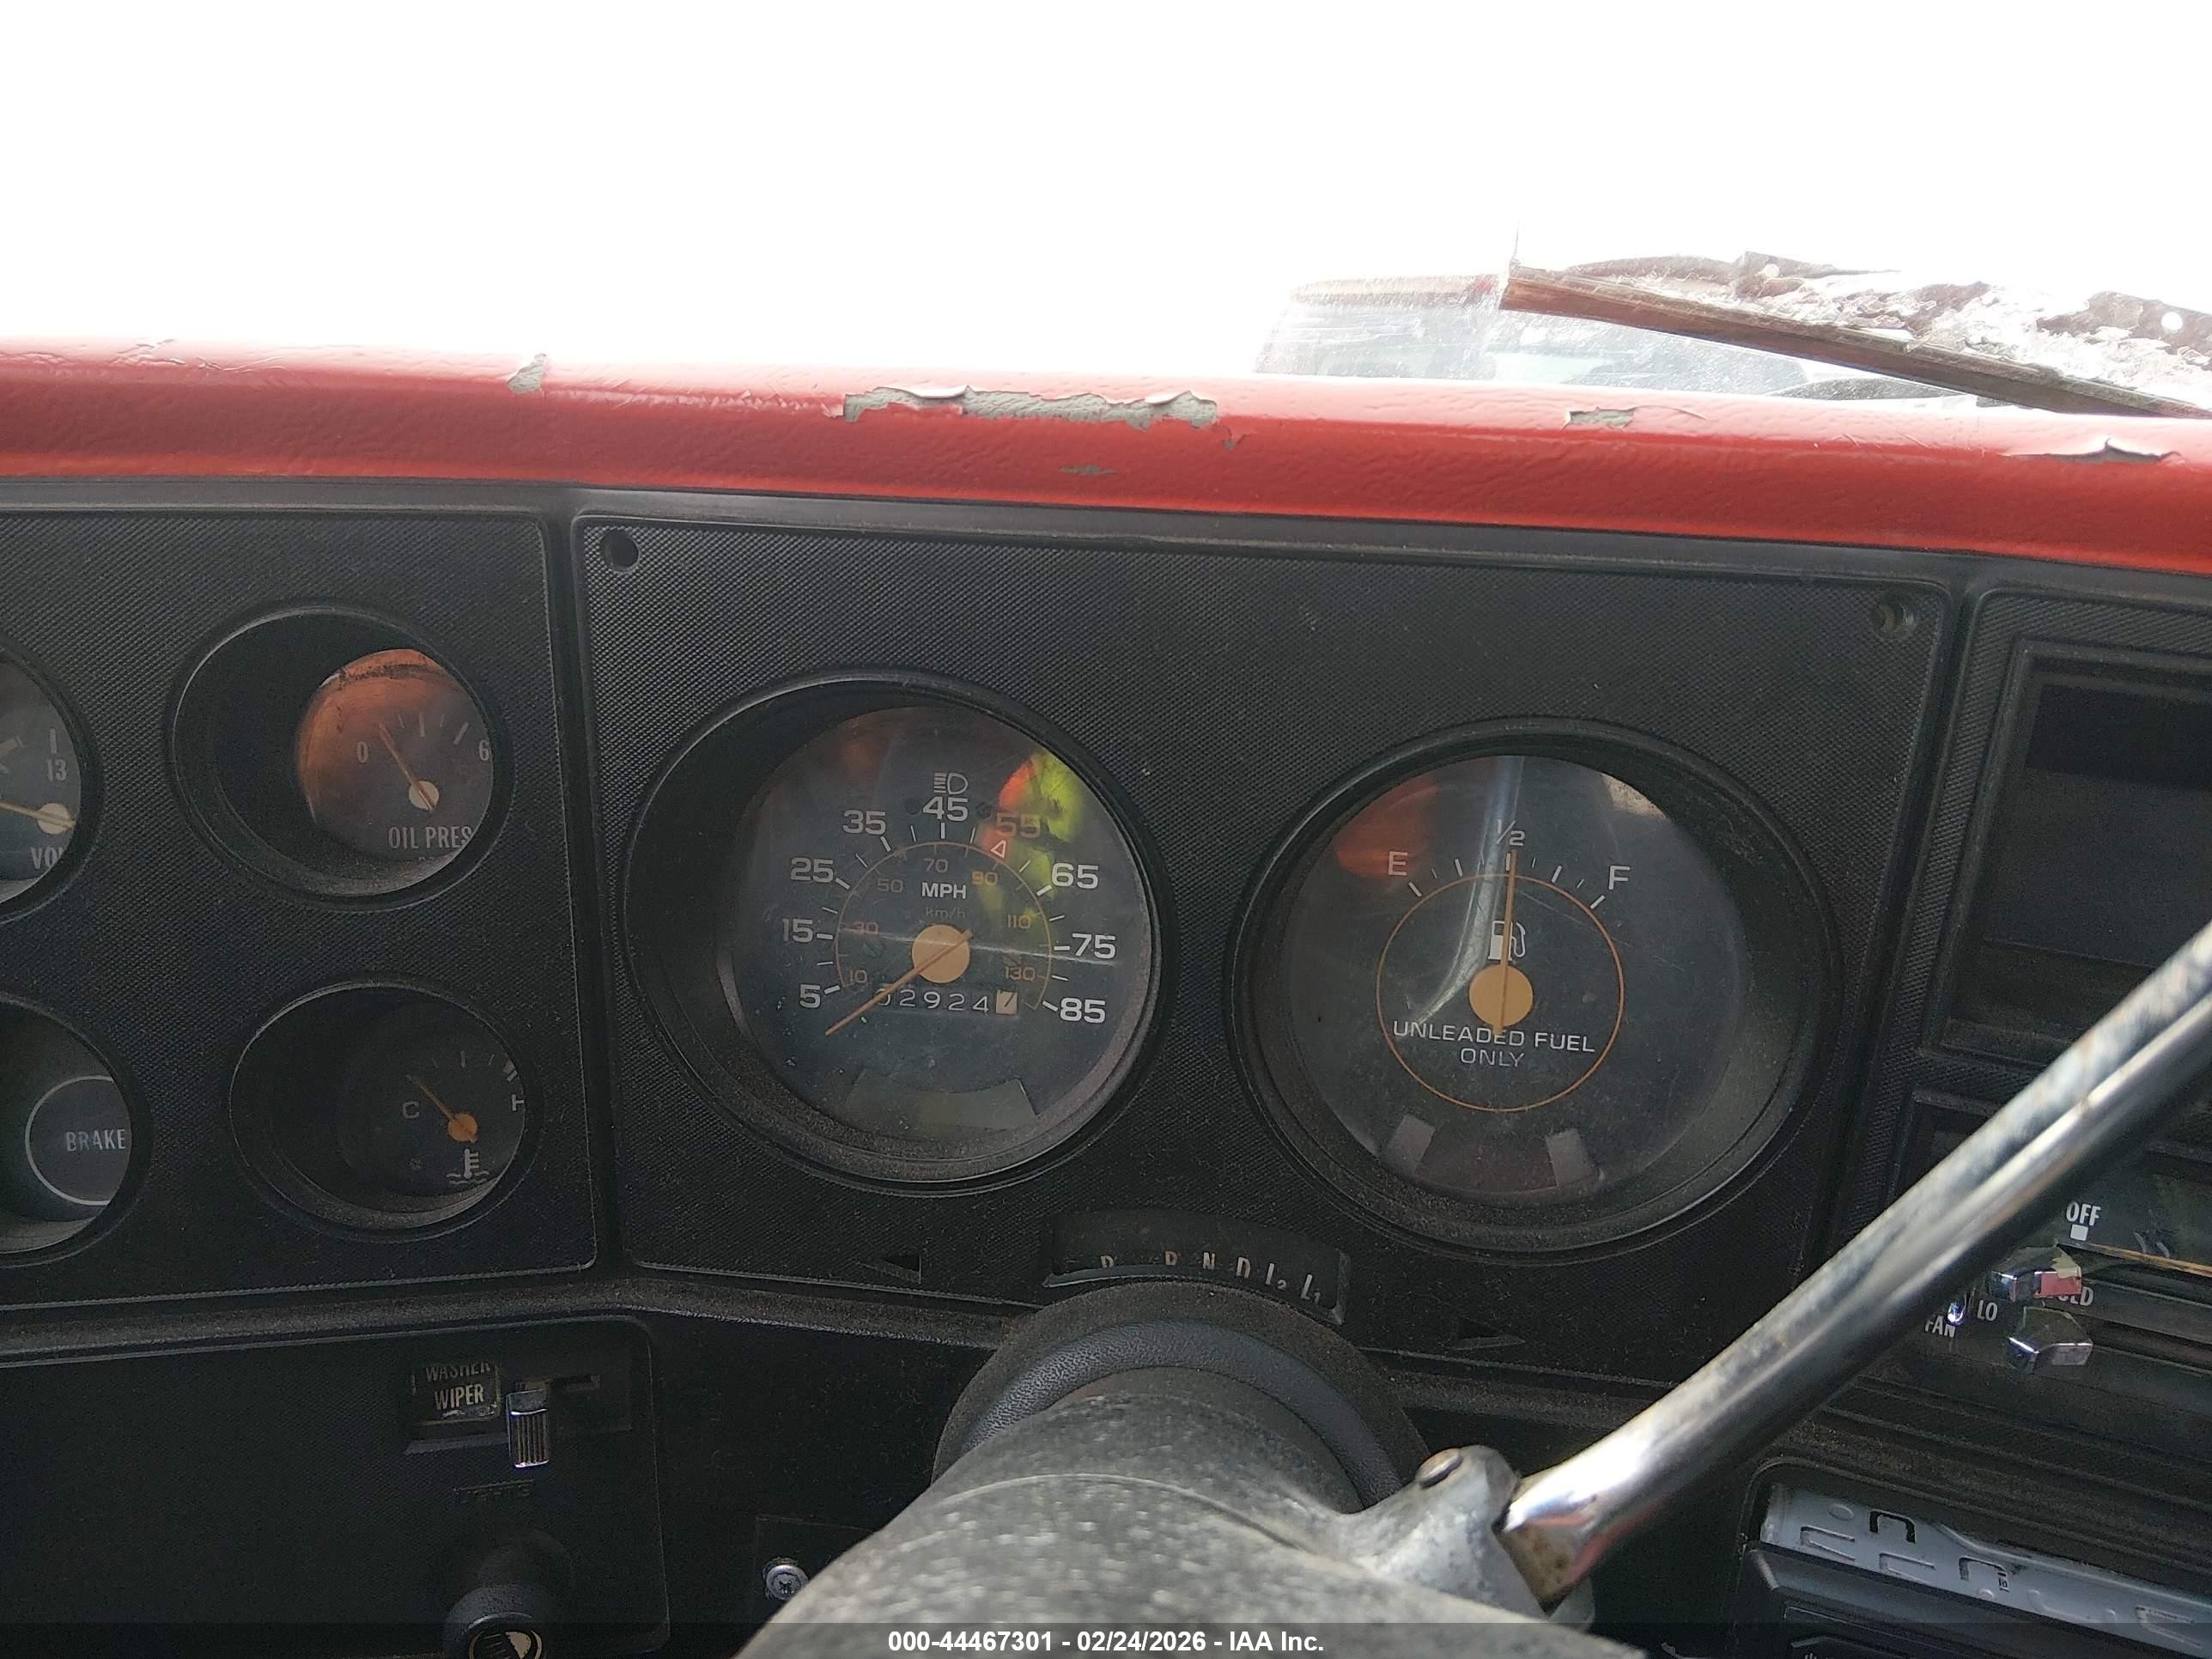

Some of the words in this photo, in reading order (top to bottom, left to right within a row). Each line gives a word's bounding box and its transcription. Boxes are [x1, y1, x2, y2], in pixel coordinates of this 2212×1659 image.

[356, 741, 369, 763] 0
[478, 739, 490, 761] 6
[46, 758, 67, 782] 13
[923, 796, 969, 822] 45
[842, 810, 887, 835] 35
[996, 812, 1041, 837] 55
[388, 826, 420, 849] OIL
[30, 846, 64, 870] VO
[924, 859, 949, 873] 70
[1388, 851, 1409, 877] E
[790, 858, 835, 884] 25
[971, 871, 999, 886] 90
[1051, 863, 1099, 889] 65
[1608, 865, 1632, 890] F
[876, 878, 903, 894] 50
[921, 882, 968, 900] MPH
[925, 905, 966, 921] km/h
[1007, 915, 1031, 929] 110
[781, 918, 814, 943] 15
[854, 921, 879, 936] 30
[1071, 933, 1116, 959] 75
[850, 969, 868, 985] 10
[1004, 967, 1036, 981] 130
[799, 984, 821, 1008] 5
[1059, 998, 1107, 1024] 85
[1393, 1020, 1526, 1047] UNLEADED
[1534, 1032, 1596, 1053] FUEL
[1461, 1048, 1527, 1068] ONLY
[402, 1101, 421, 1120] C
[65, 1129, 126, 1152] BRAKE
[2065, 1201, 2102, 1227] OFF
[1202, 1251, 1217, 1271] N
[1977, 1299, 1999, 1322] LO
[434, 1382, 485, 1411] WIPER
